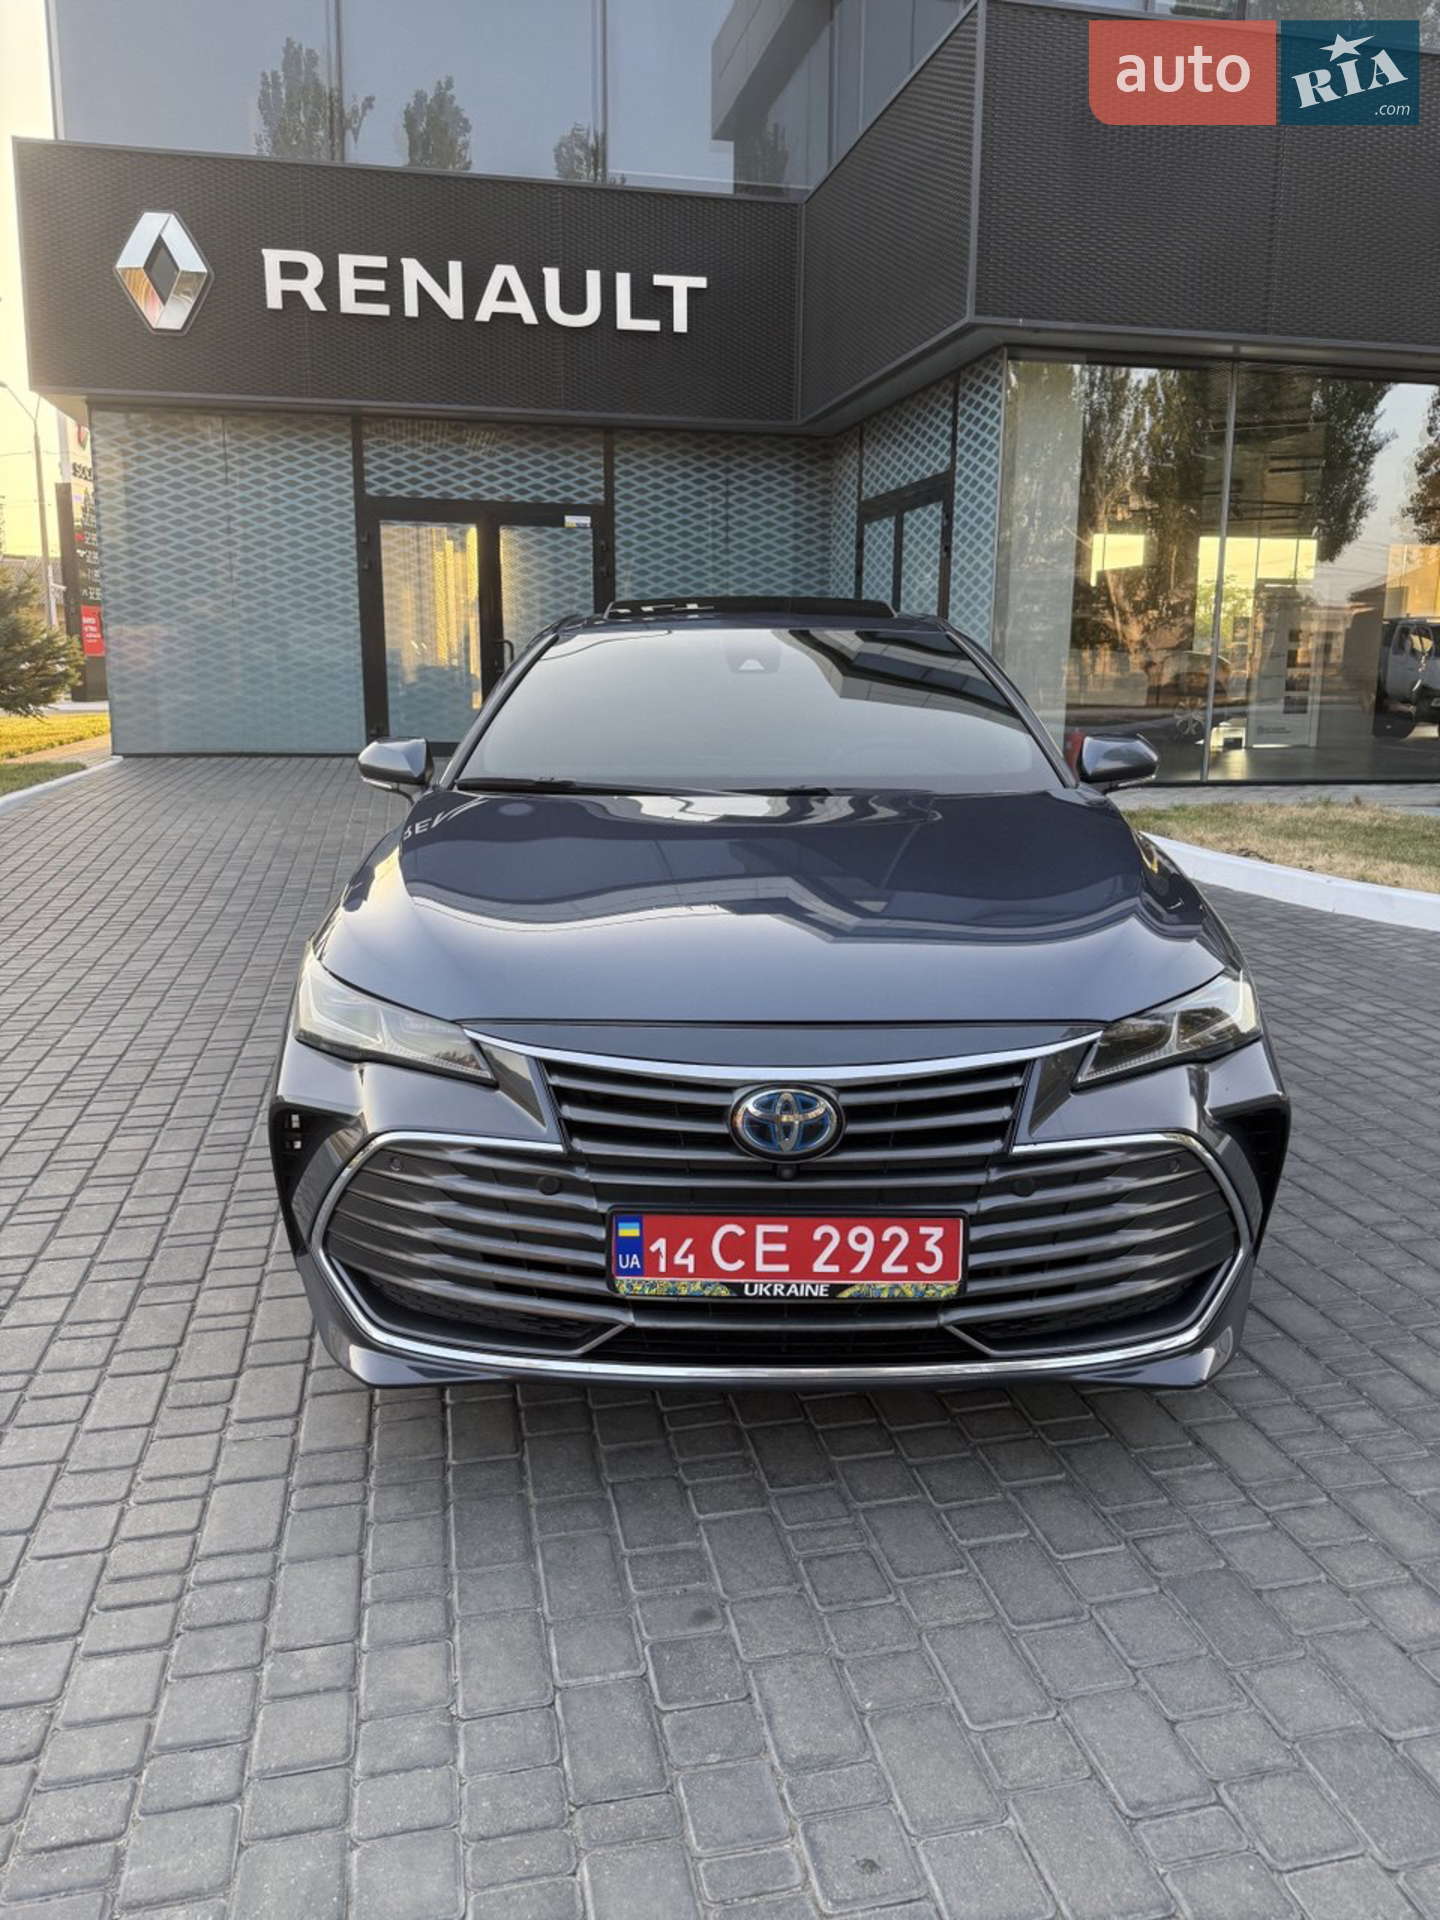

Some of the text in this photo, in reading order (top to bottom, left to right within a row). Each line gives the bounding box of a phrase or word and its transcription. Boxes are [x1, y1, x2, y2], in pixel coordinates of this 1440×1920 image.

[261, 248, 708, 333] RENAULT
[618, 1254, 641, 1269] UA
[649, 1223, 945, 1275] 14 CE 2923
[744, 1283, 830, 1298] UKRAINE
